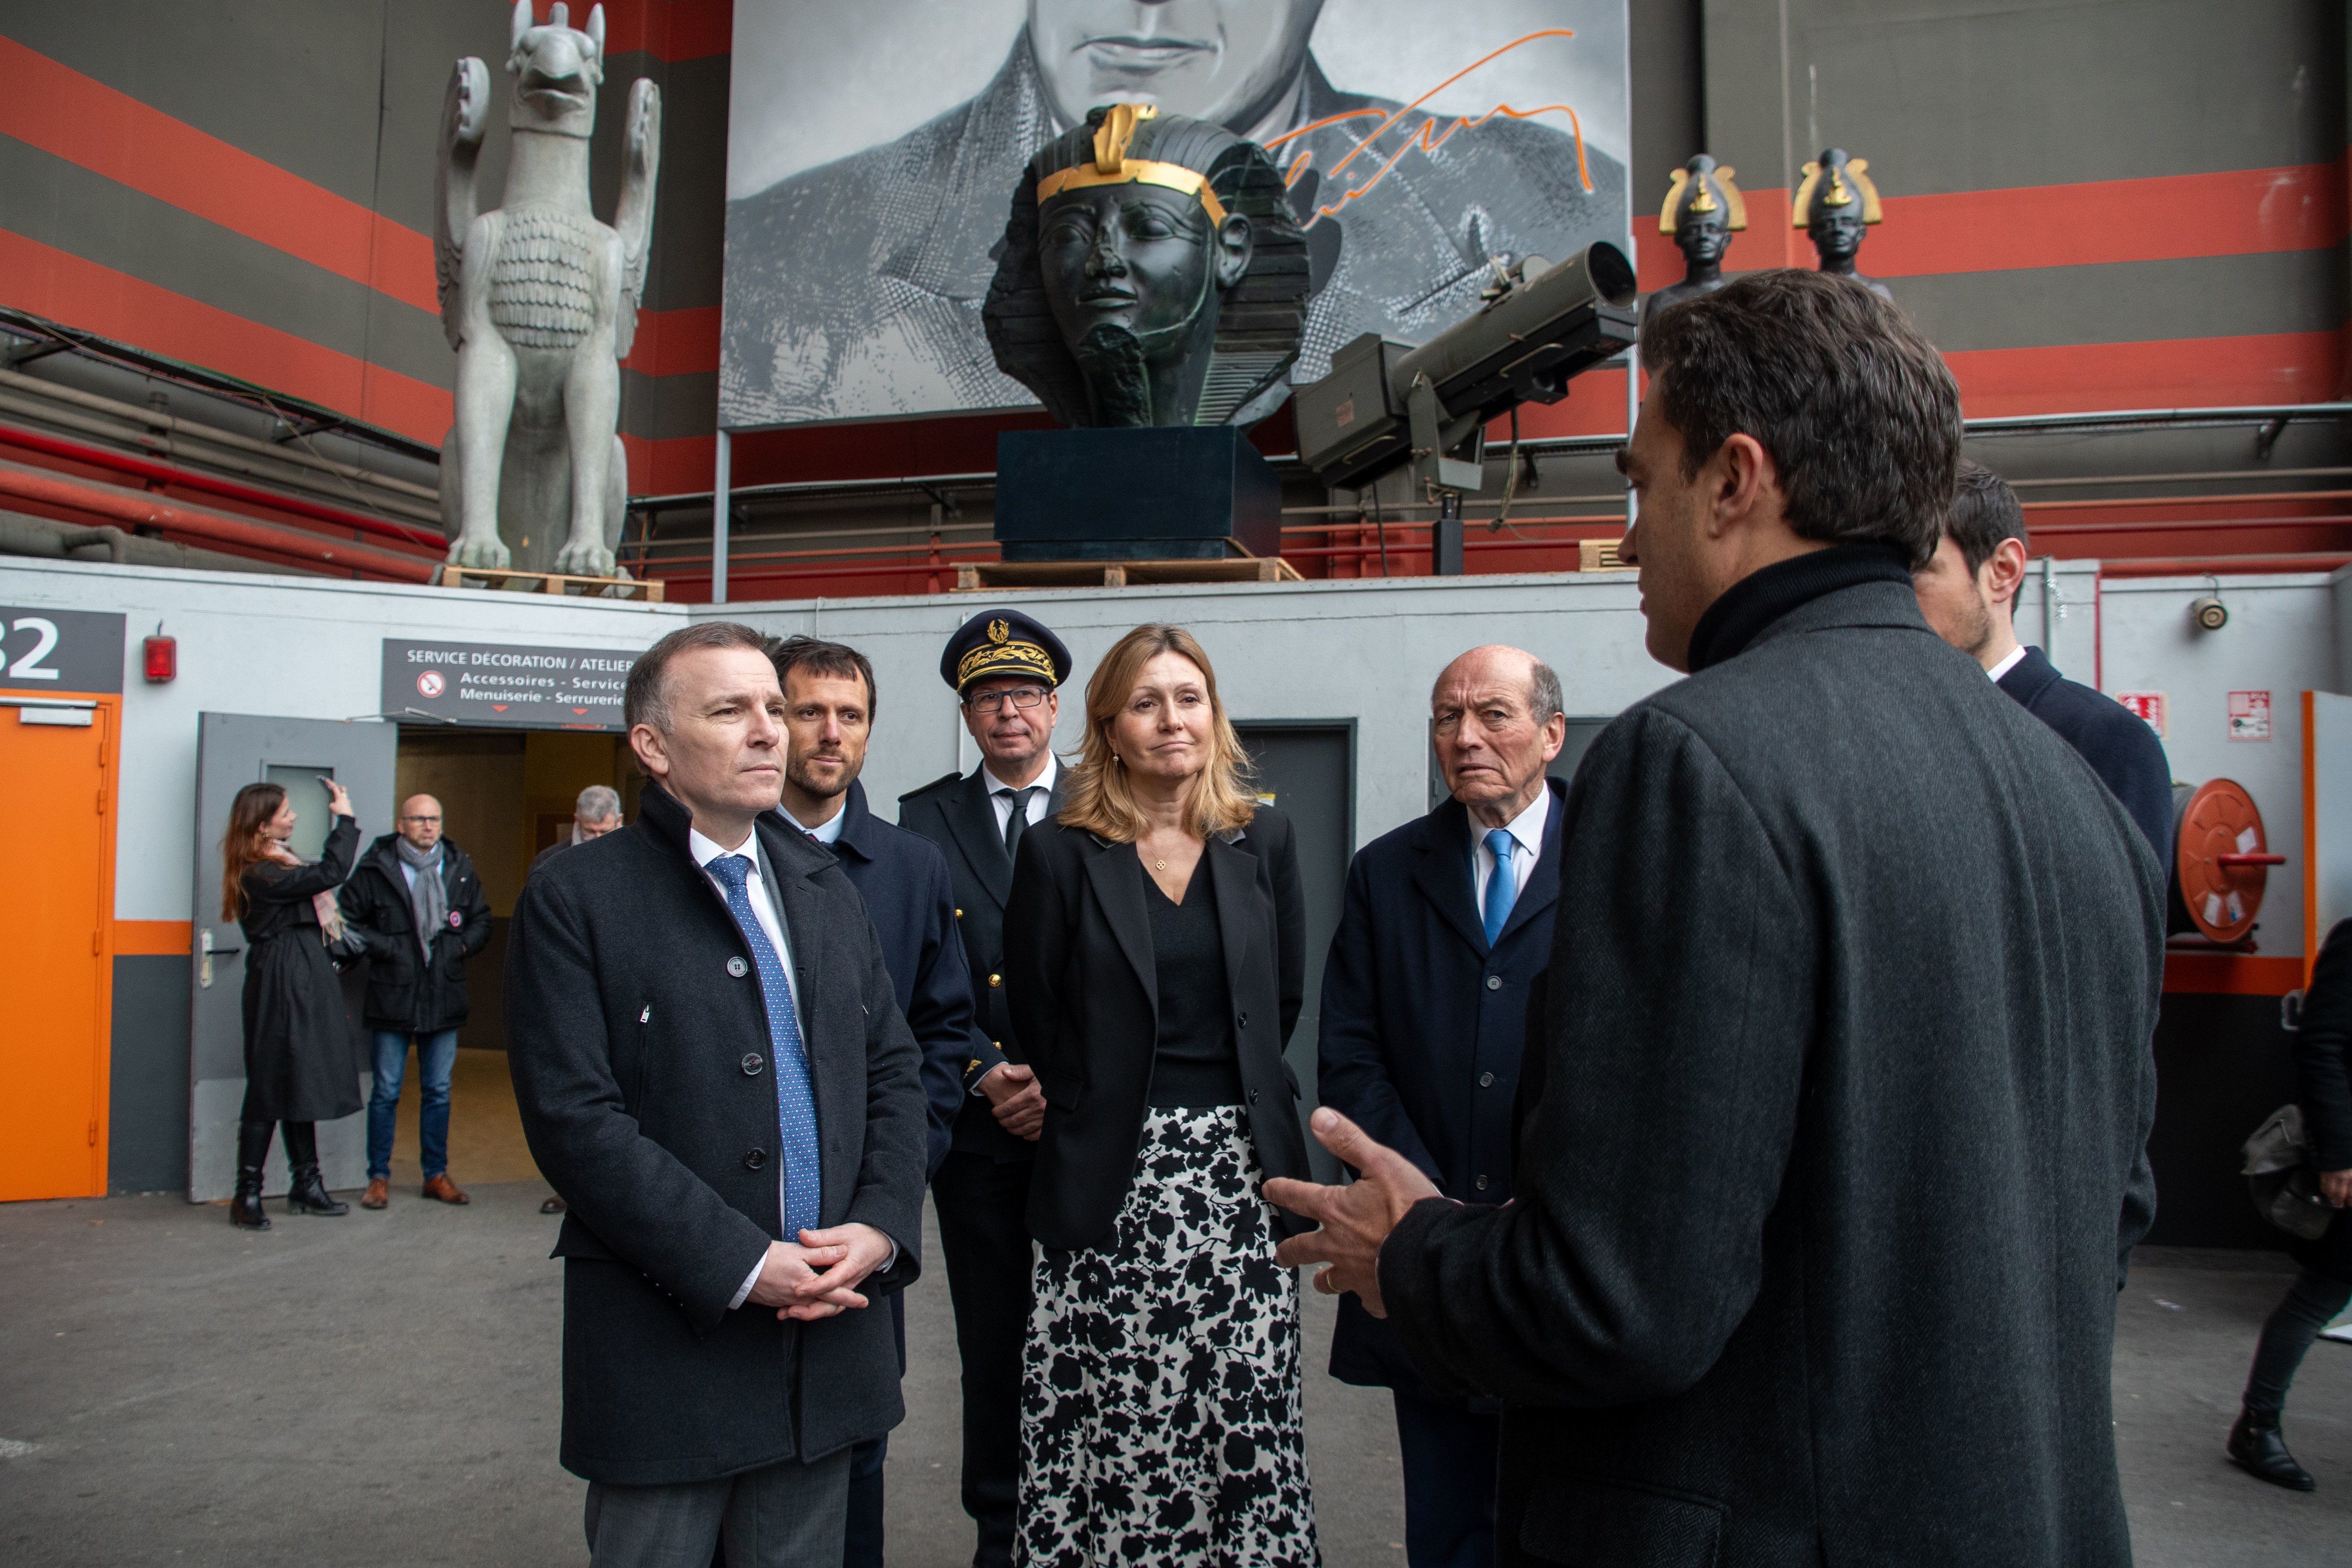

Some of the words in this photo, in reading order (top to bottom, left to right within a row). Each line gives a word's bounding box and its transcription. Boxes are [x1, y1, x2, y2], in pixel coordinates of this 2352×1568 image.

[0, 617, 60, 680] 2
[407, 650, 468, 664] SERVICE
[471, 651, 567, 669] DÉCORATION
[460, 672, 556, 687] Accessoires
[460, 688, 543, 703] Menuiserie
[555, 692, 625, 706] Serrurerie
